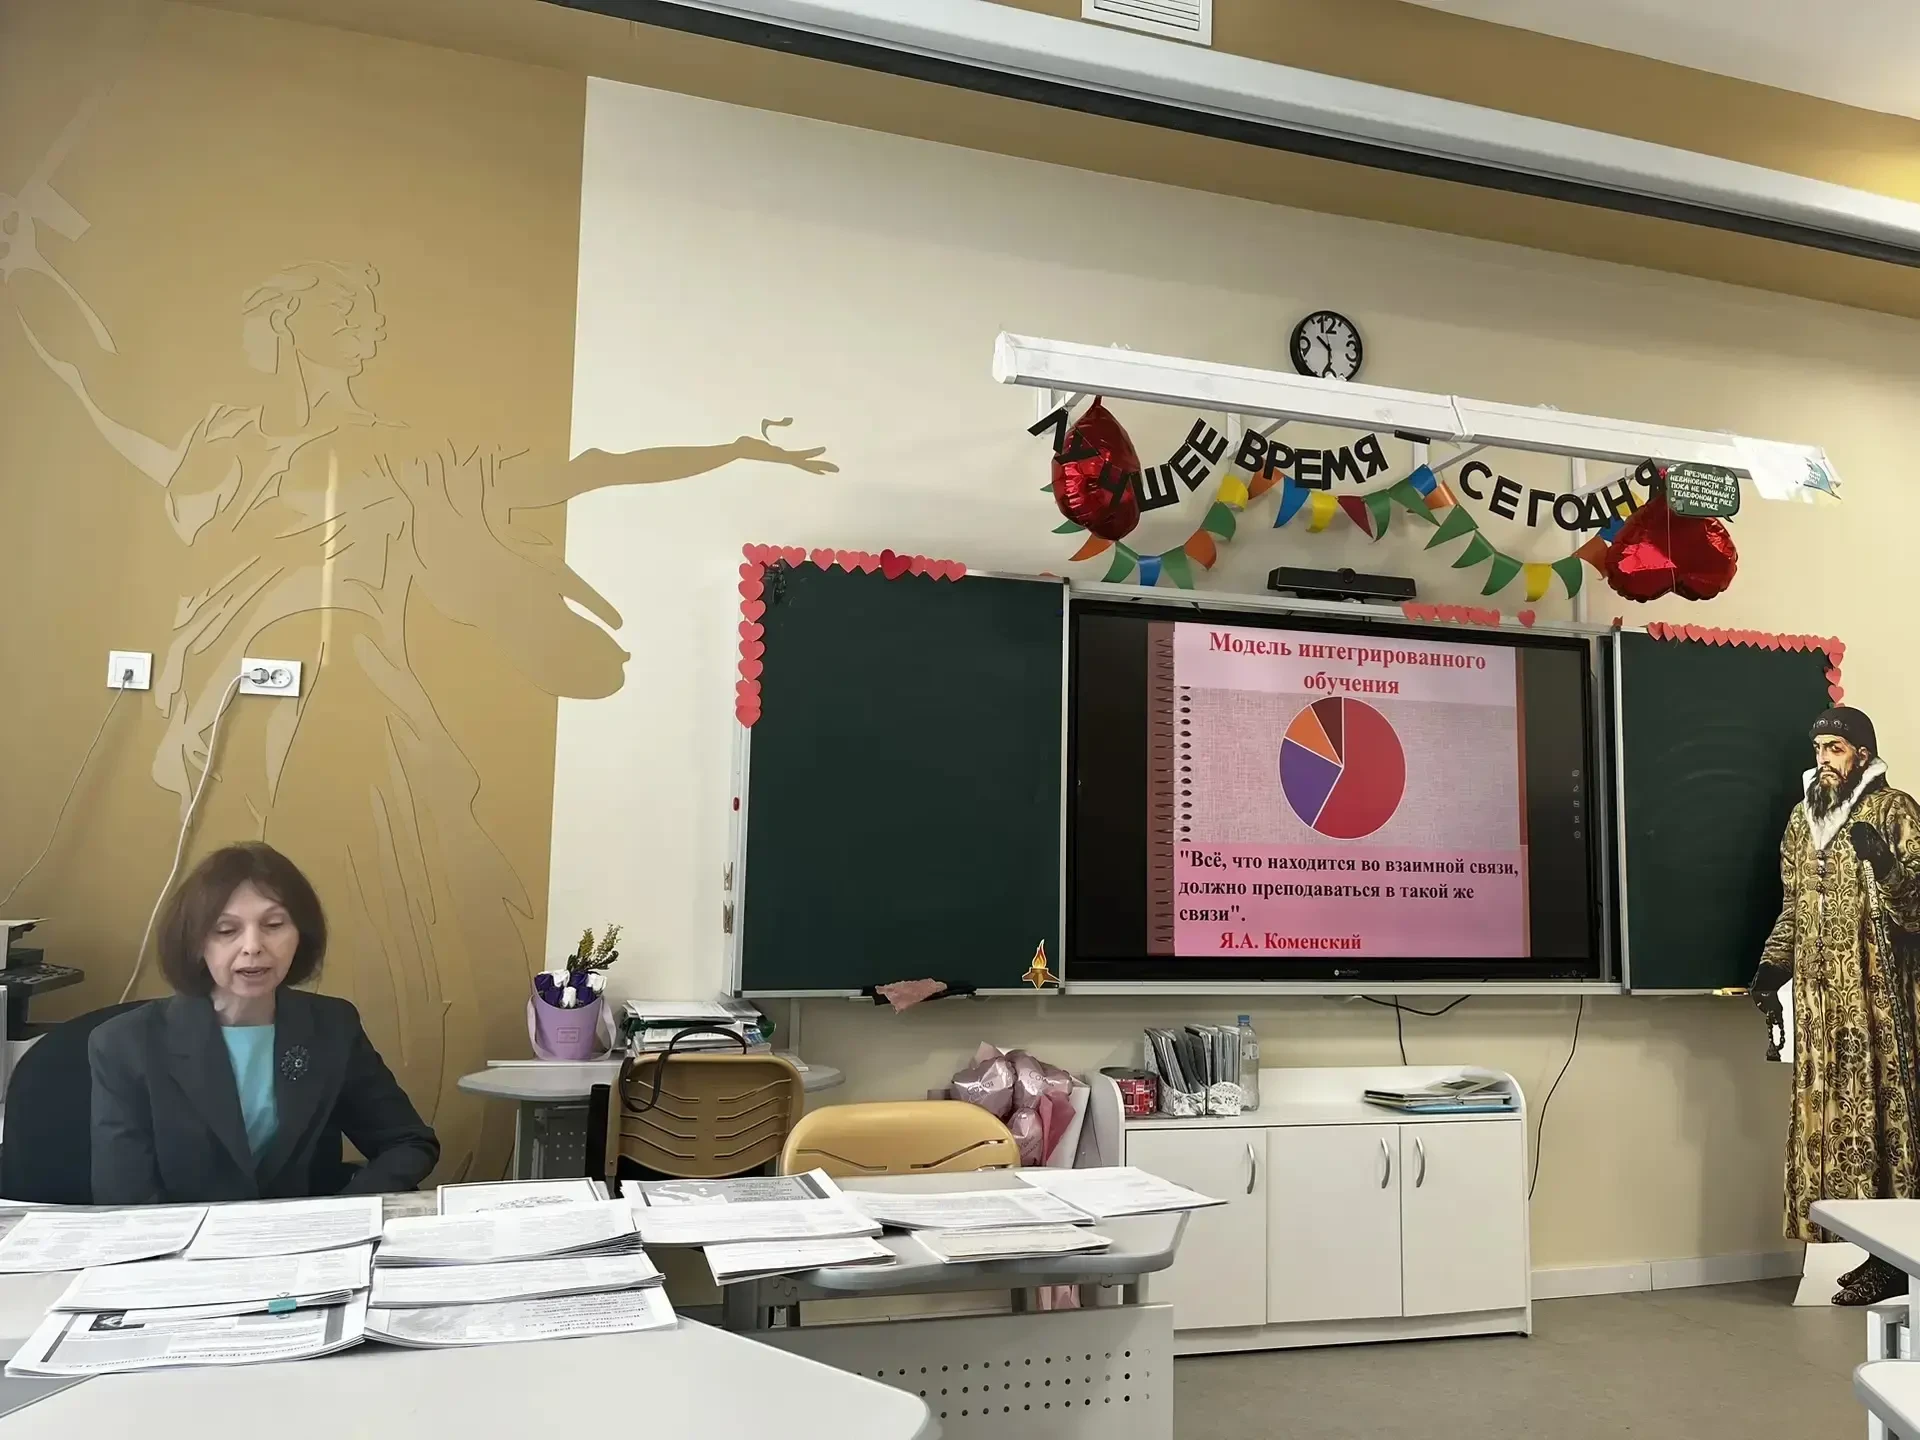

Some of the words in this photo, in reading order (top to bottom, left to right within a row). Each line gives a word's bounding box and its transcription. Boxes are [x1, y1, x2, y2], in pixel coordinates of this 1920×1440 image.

[1316, 315, 1337, 335] 12
[1300, 335, 1312, 357] 9
[1345, 340, 1357, 363] 3
[1234, 428, 1390, 491] ВРЕМЯ
[1459, 457, 1664, 533] СЕГОДНЯ
[1670, 474, 1719, 490] НЕВИНОВНОСТИ
[1724, 485, 1736, 493] ЭТО
[1684, 469, 1724, 484] ПРЕЗУМПЦИЯ
[1671, 482, 1689, 491] ПОКА
[1673, 489, 1712, 502] ТЕЛЕФОНОМ
[1719, 498, 1733, 507] РУКЕ
[1701, 501, 1719, 511] УРОКЕ
[1209, 631, 1292, 656] Модель
[1298, 643, 1486, 670] интегрированного
[1303, 671, 1399, 695] обучения
[1180, 850, 1227, 870] "Всё,
[1232, 856, 1262, 869] что
[1268, 857, 1356, 872] находится
[1361, 859, 1380, 872] во
[1385, 858, 1465, 873] взаимной
[1469, 861, 1519, 877] связи,
[1179, 882, 1247, 896] должно
[1252, 882, 1380, 900] преподаваться
[1385, 887, 1395, 898] в
[1400, 883, 1449, 899] такой
[1453, 887, 1475, 899] же
[1179, 904, 1246, 922] связи".
[1219, 932, 1259, 949] Я.А.
[1264, 932, 1362, 950] Коменский
